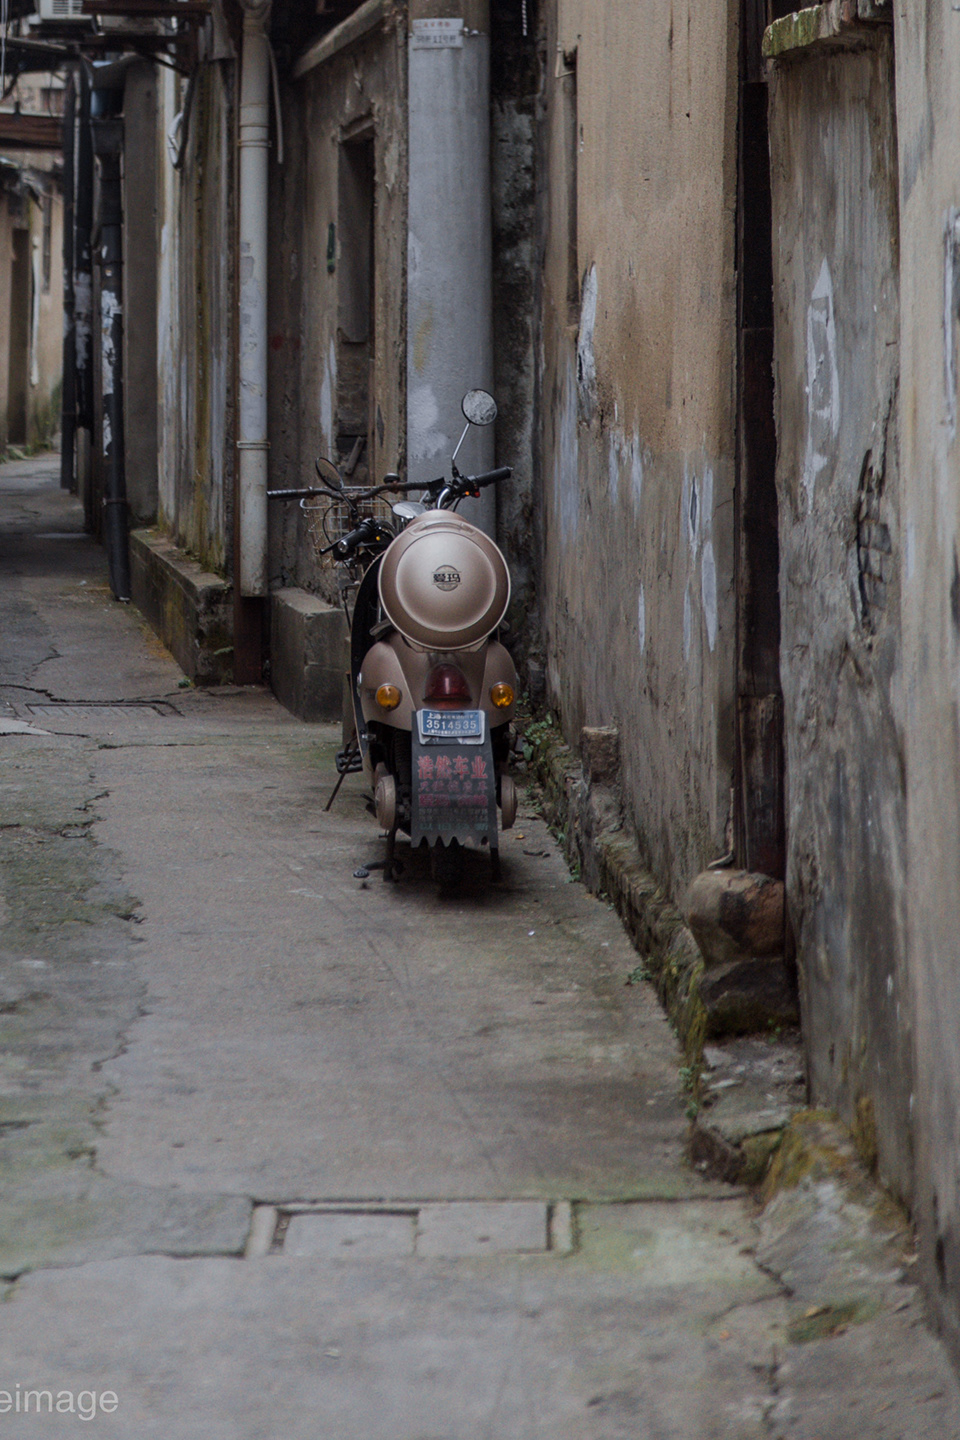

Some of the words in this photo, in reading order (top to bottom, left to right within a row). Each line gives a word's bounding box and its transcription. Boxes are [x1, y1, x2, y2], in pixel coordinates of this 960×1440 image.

[433, 573, 461, 582] 爱玛
[426, 720, 477, 729] 3514535
[417, 755, 488, 780] 浩然车业
